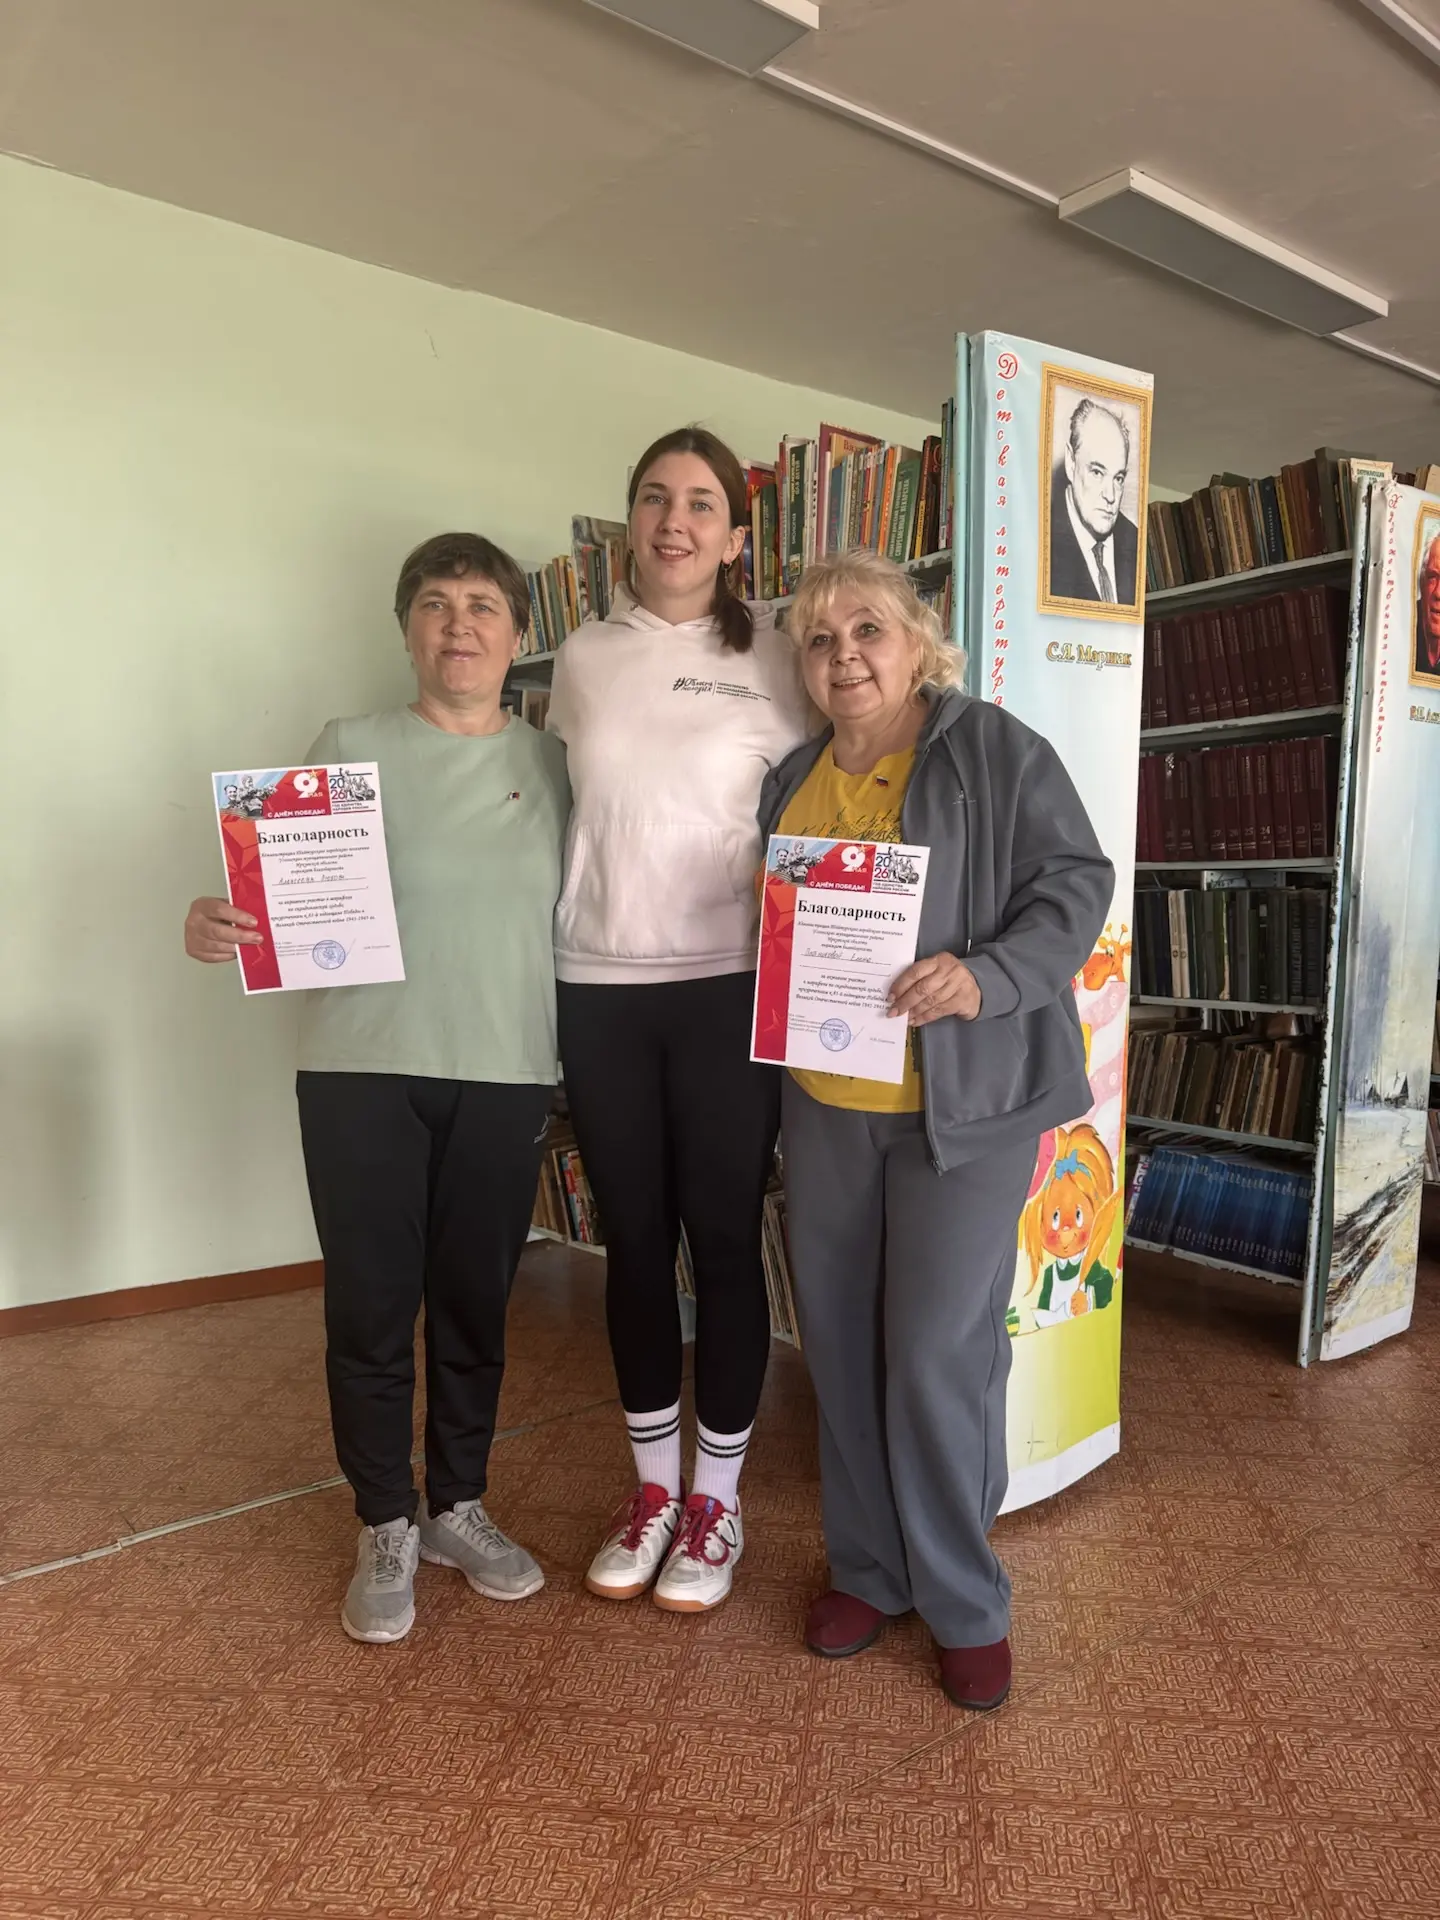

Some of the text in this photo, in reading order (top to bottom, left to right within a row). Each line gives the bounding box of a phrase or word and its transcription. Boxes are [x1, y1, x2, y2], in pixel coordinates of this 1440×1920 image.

[1077, 644, 1132, 671] Маршак
[329, 778, 345, 789] 20
[331, 789, 345, 800] 26
[258, 827, 369, 844] Благодарность
[875, 856, 890, 867] 20
[874, 868, 889, 879] 26
[798, 900, 906, 922] Благодарность
